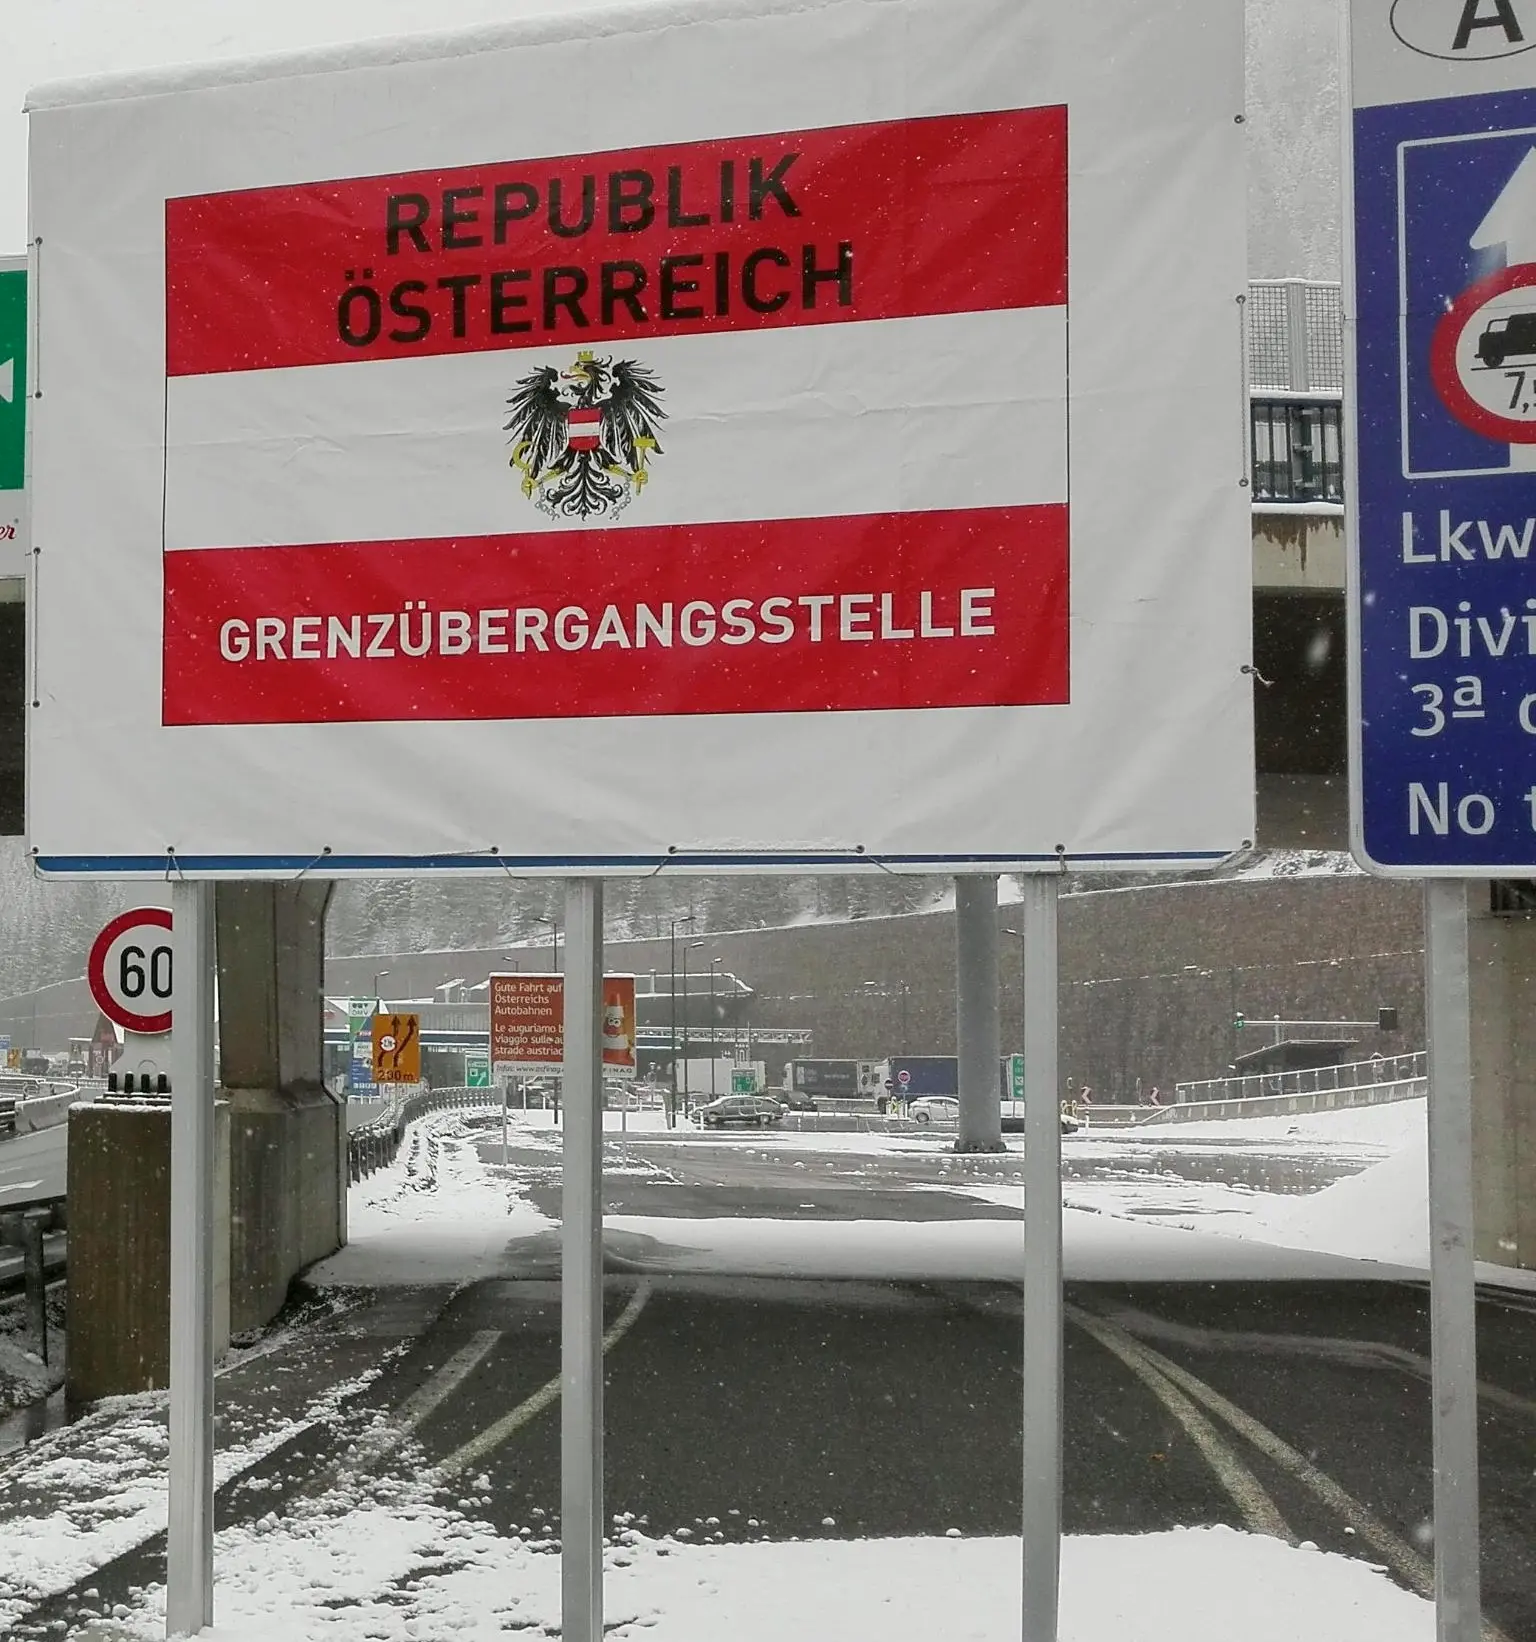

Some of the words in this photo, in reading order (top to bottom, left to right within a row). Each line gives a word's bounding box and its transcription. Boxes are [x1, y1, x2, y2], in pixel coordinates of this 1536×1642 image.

[1451, 0, 1525, 50] A
[385, 152, 803, 255] REPUBLIK
[337, 240, 854, 348] ÖSTERREICH
[1504, 371, 1536, 413] 7,
[1402, 509, 1536, 563] Lkw
[220, 587, 997, 663] GRENZÜBERGANGSSTELLE
[1409, 782, 1495, 835] No
[120, 945, 173, 998] 60
[494, 982, 517, 993] Gute
[519, 982, 544, 993] Fahrt
[547, 983, 563, 993] auf
[494, 993, 550, 1004] Österreichs
[494, 1006, 552, 1016] Autobahnen
[494, 1034, 528, 1046] viaggio
[494, 1046, 525, 1055] strade
[495, 1023, 505, 1033] Le
[507, 1023, 556, 1035] auguriamo
